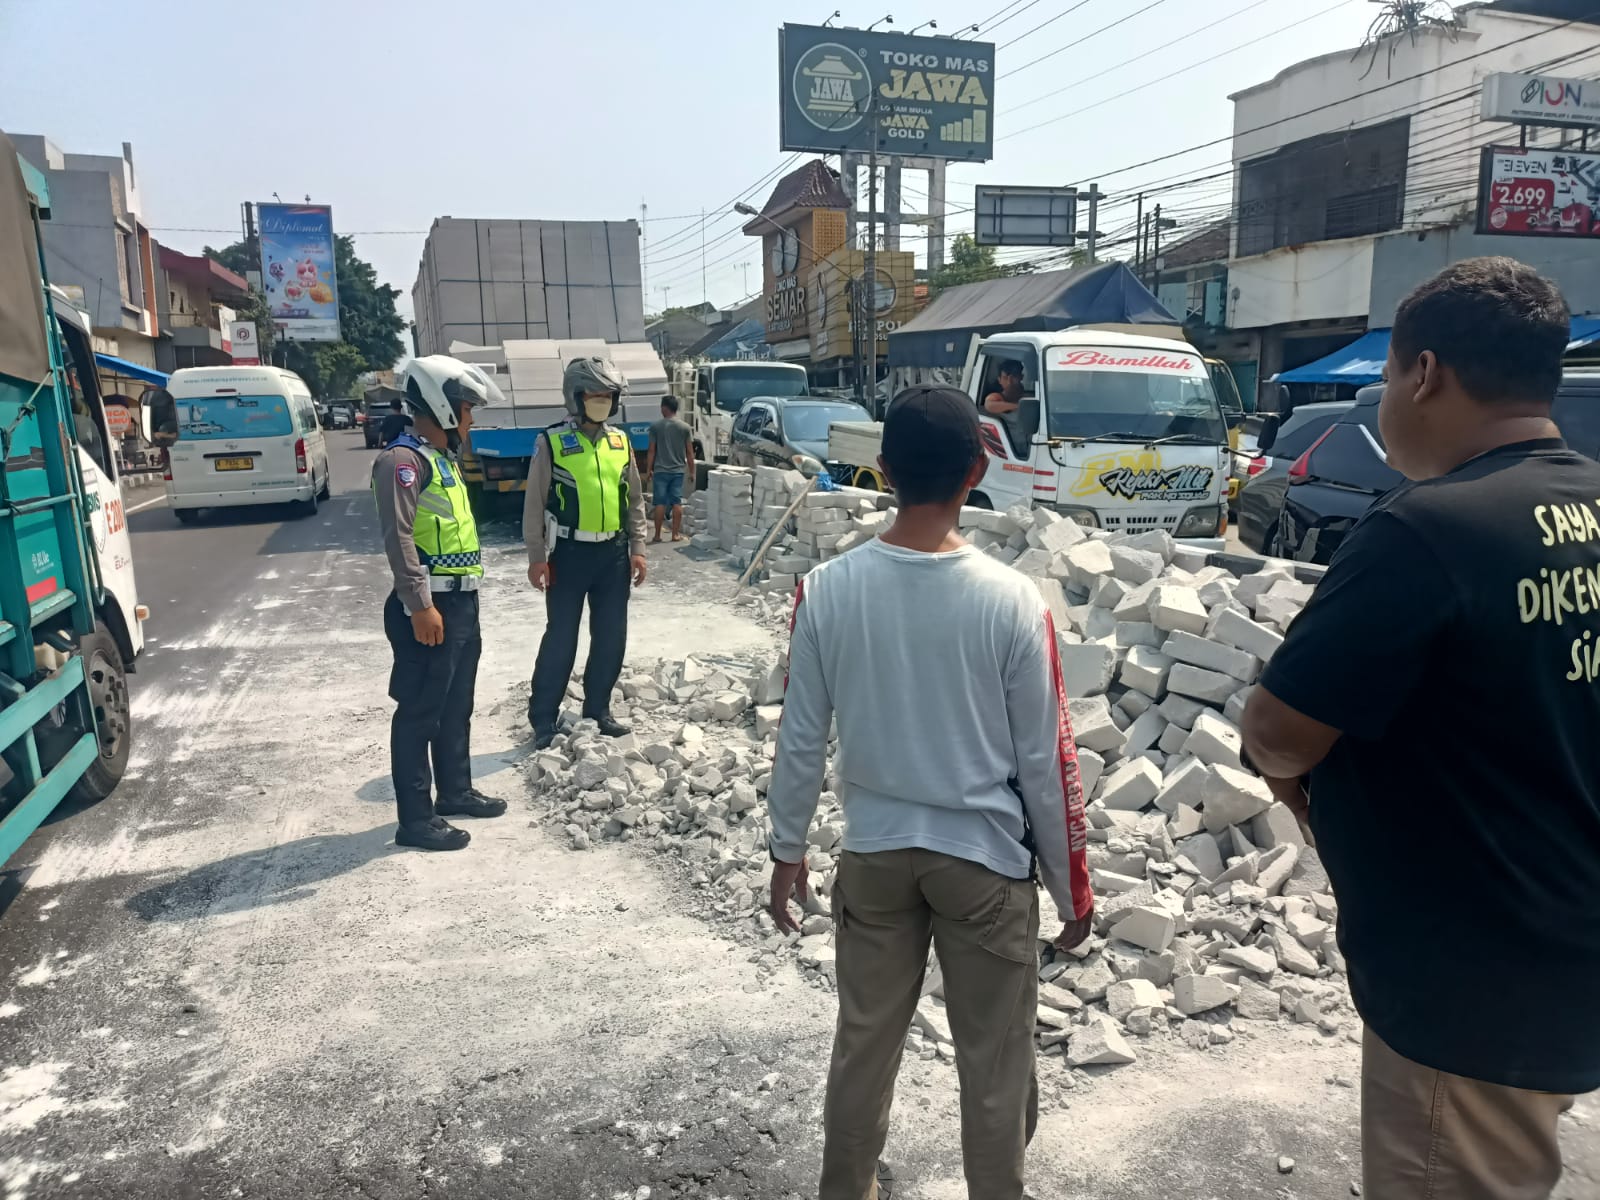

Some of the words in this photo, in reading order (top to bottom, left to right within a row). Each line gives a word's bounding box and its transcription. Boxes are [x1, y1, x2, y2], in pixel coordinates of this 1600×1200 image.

[879, 50, 939, 68] TOKO
[945, 57, 989, 72] MAS
[810, 77, 855, 102] JAWA
[879, 69, 989, 106] JAWA
[909, 106, 933, 115] MULIA
[880, 114, 930, 130] JAWA
[887, 128, 925, 140] GOLD
[1504, 160, 1546, 174] ELEVEN
[1499, 186, 1546, 205] 2.699
[767, 286, 806, 322] SEMAR
[1058, 351, 1193, 370] Bismillah
[1534, 502, 1600, 547] SAYA
[1065, 759, 1085, 817] URBAN
[1071, 817, 1087, 853] NYC
